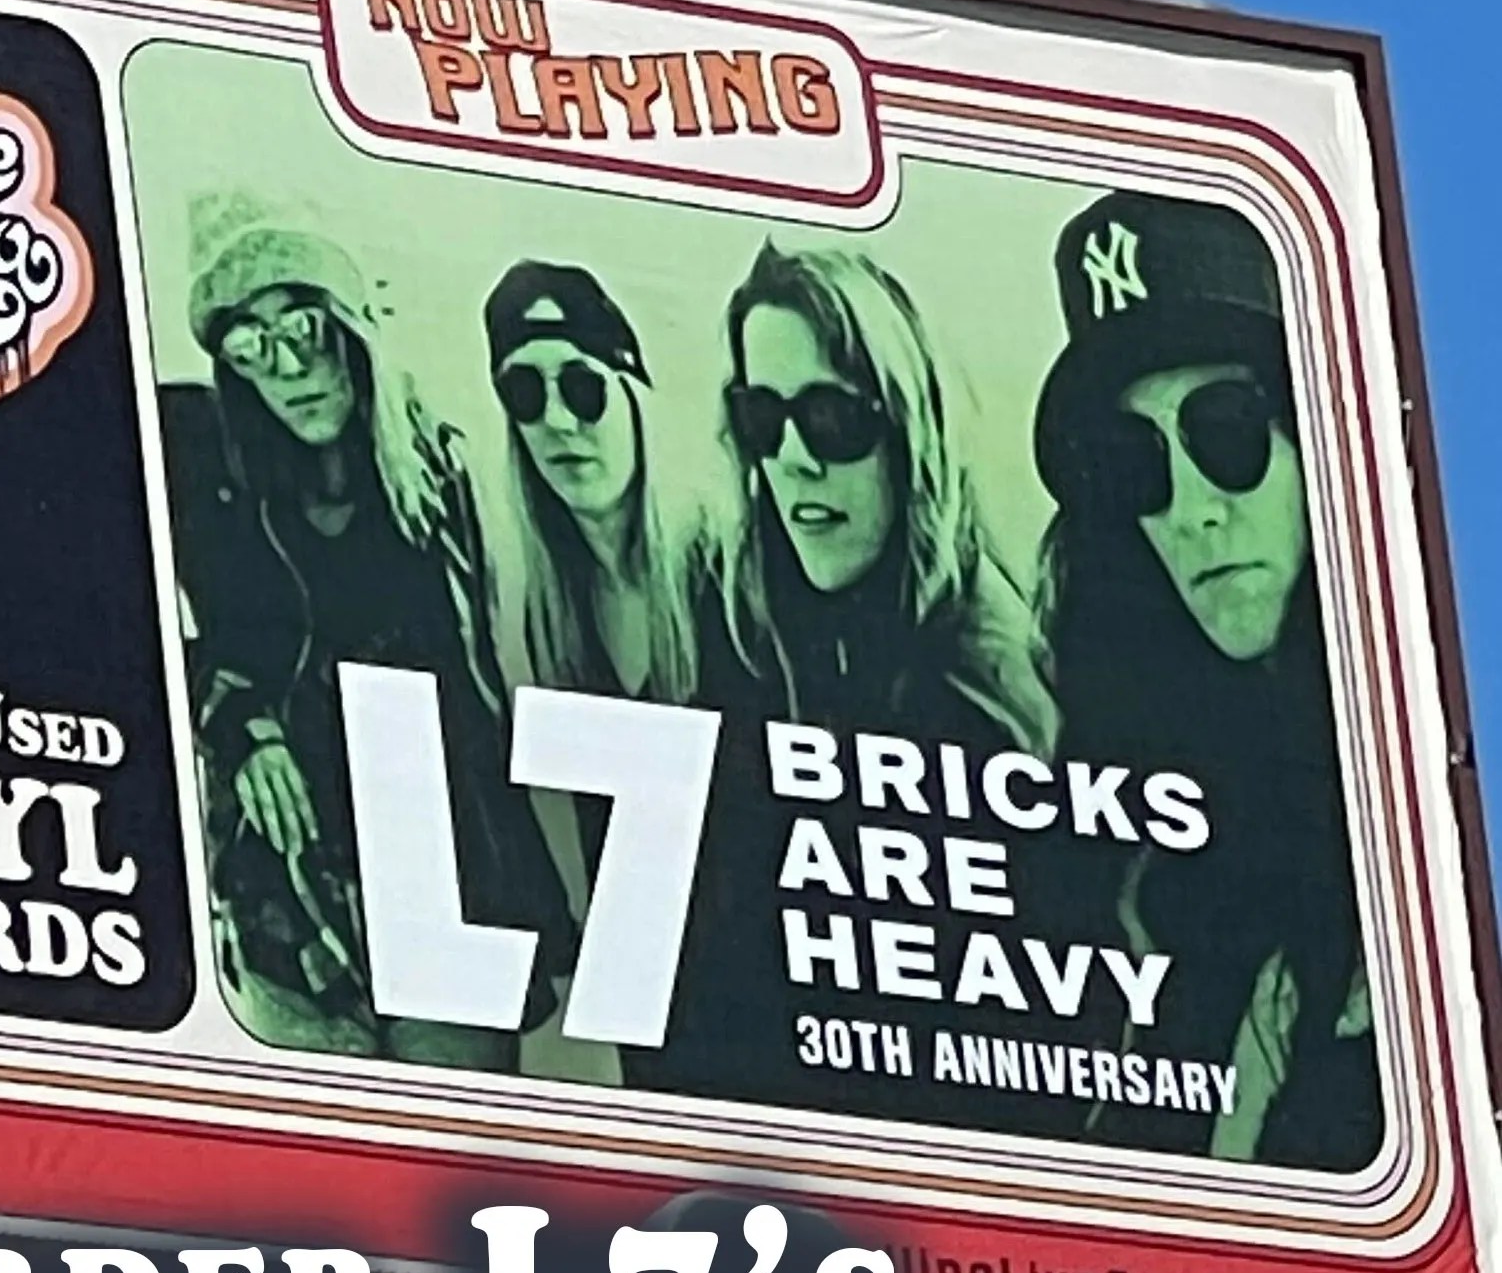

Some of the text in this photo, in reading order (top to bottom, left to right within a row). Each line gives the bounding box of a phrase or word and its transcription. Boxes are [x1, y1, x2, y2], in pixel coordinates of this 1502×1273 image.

[418, 31, 843, 139] PLAYING
[765, 719, 1212, 851] BRICKS
[336, 660, 723, 1049] L7
[778, 817, 1016, 918] ARE
[780, 908, 1175, 1027] HEAVY
[796, 1015, 1239, 1116] 30TH ANNIVERSARY
